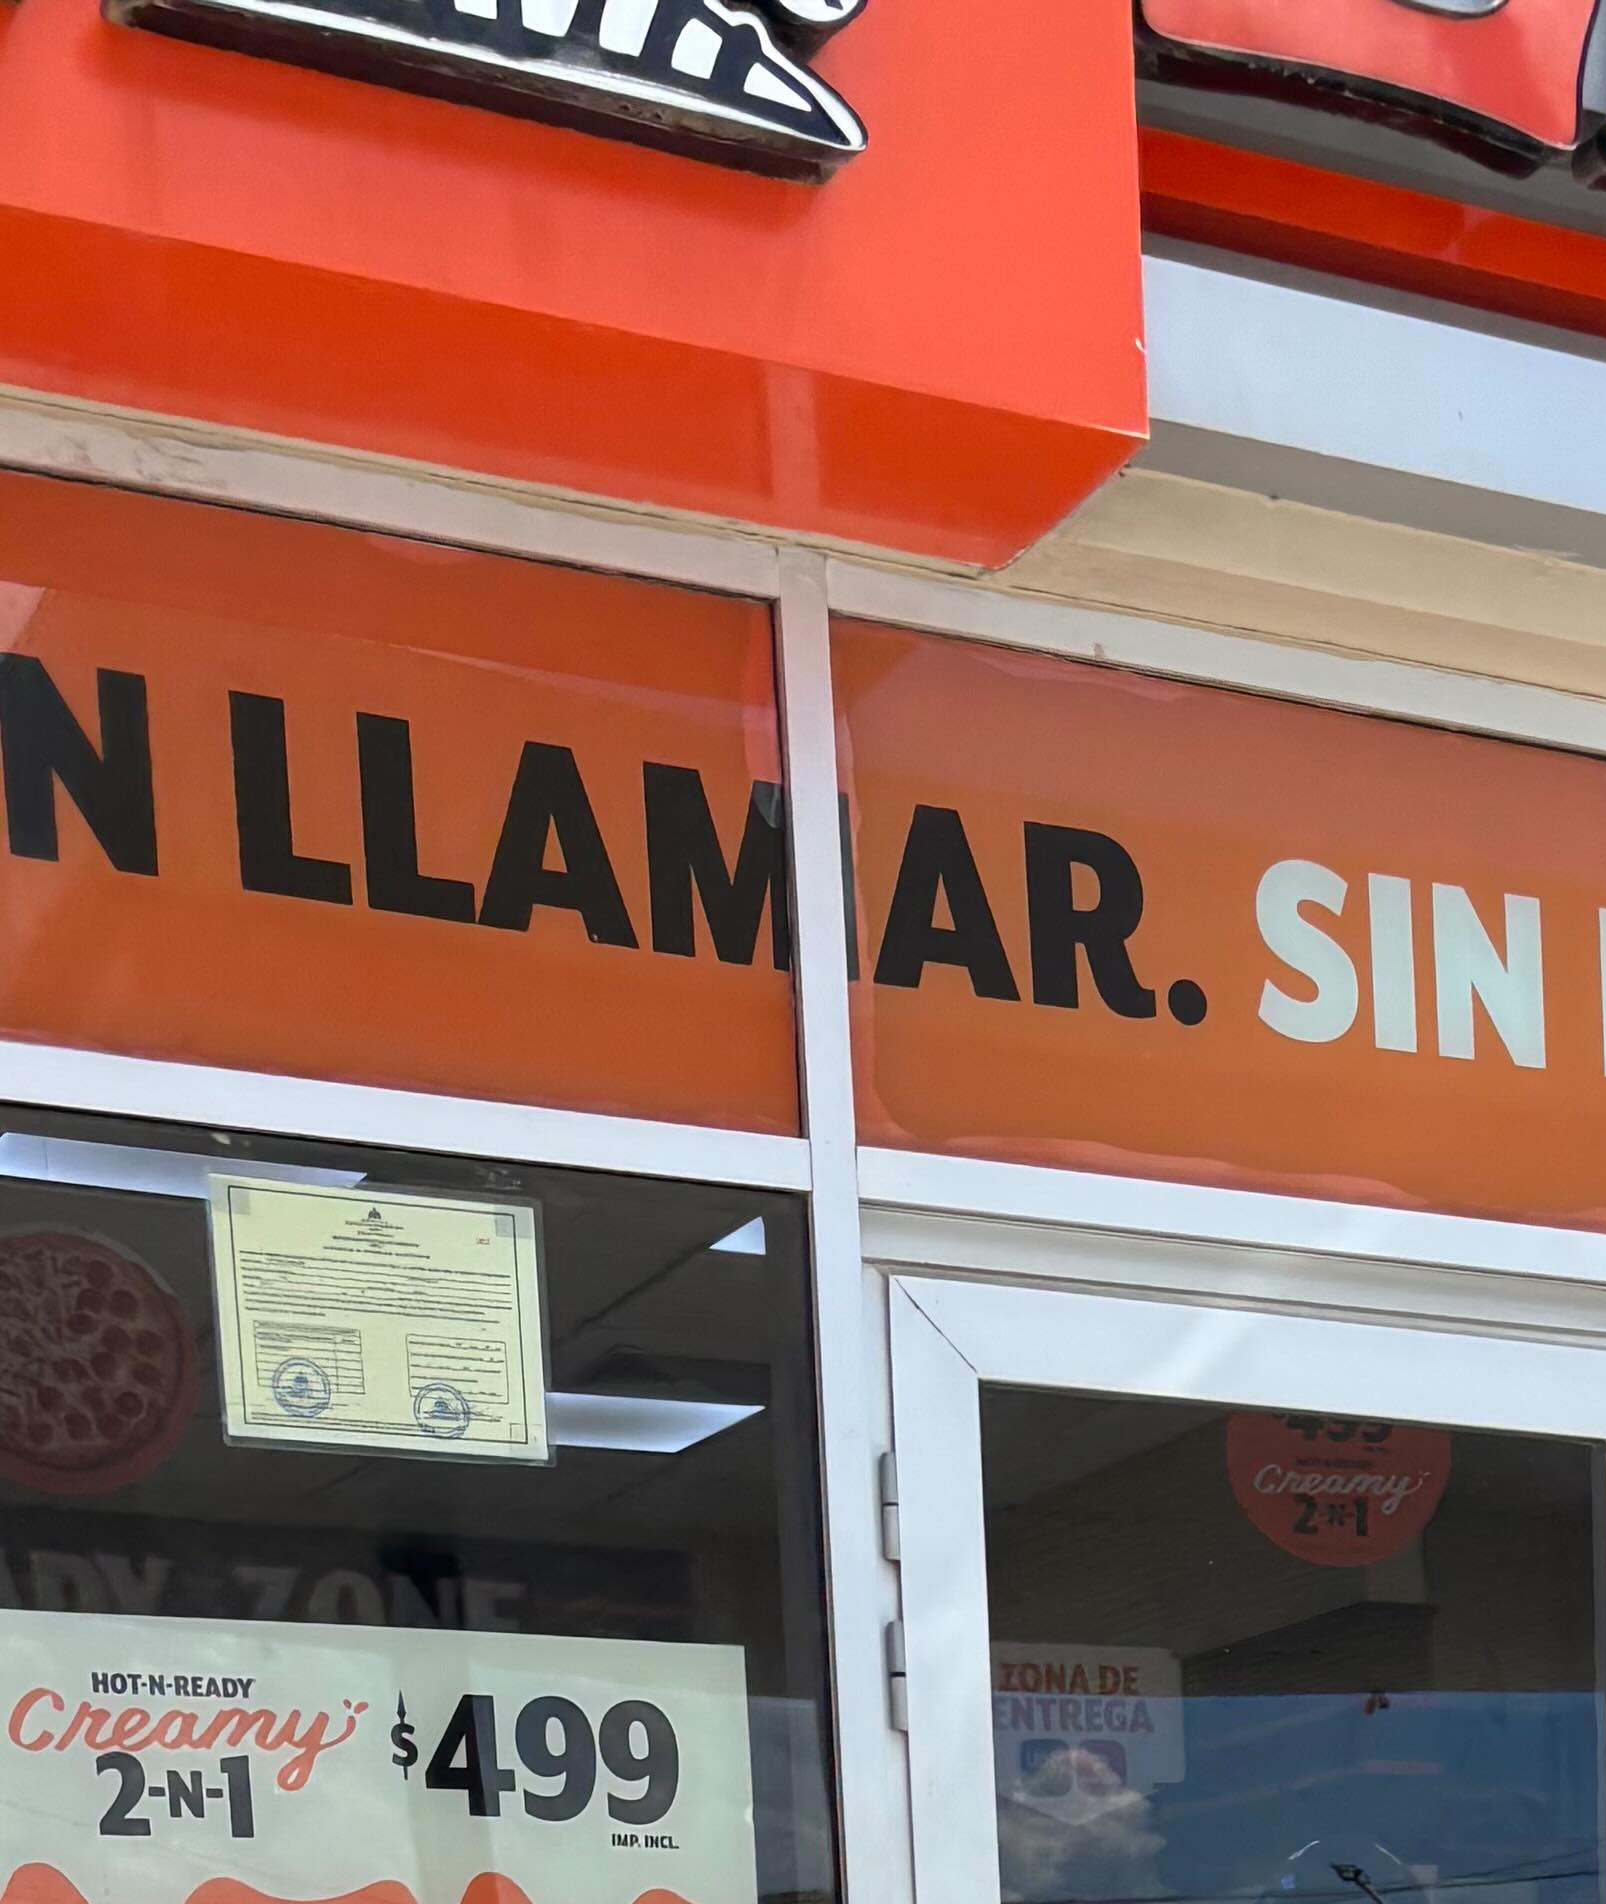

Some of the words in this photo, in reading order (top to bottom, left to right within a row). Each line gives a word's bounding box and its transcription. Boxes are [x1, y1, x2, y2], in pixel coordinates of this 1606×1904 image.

[227, 688, 1209, 1026] LLAMAR.
[1256, 858, 1547, 1070] SIN
[1254, 1464, 1428, 1514] Creamy
[0, 1546, 176, 1613] DY
[234, 1565, 526, 1632] ZONE
[91, 1672, 254, 1698] HOT-N-READY
[999, 1663, 1089, 1694] ZONA
[1098, 1665, 1141, 1695] DE
[8, 1687, 360, 1791] Creamy
[992, 1696, 1155, 1733] ENTREGA
[390, 1689, 679, 1825] $499
[96, 1752, 254, 1838] 2-N-1
[612, 1833, 641, 1848] IMP.
[645, 1835, 679, 1849] INCL.
